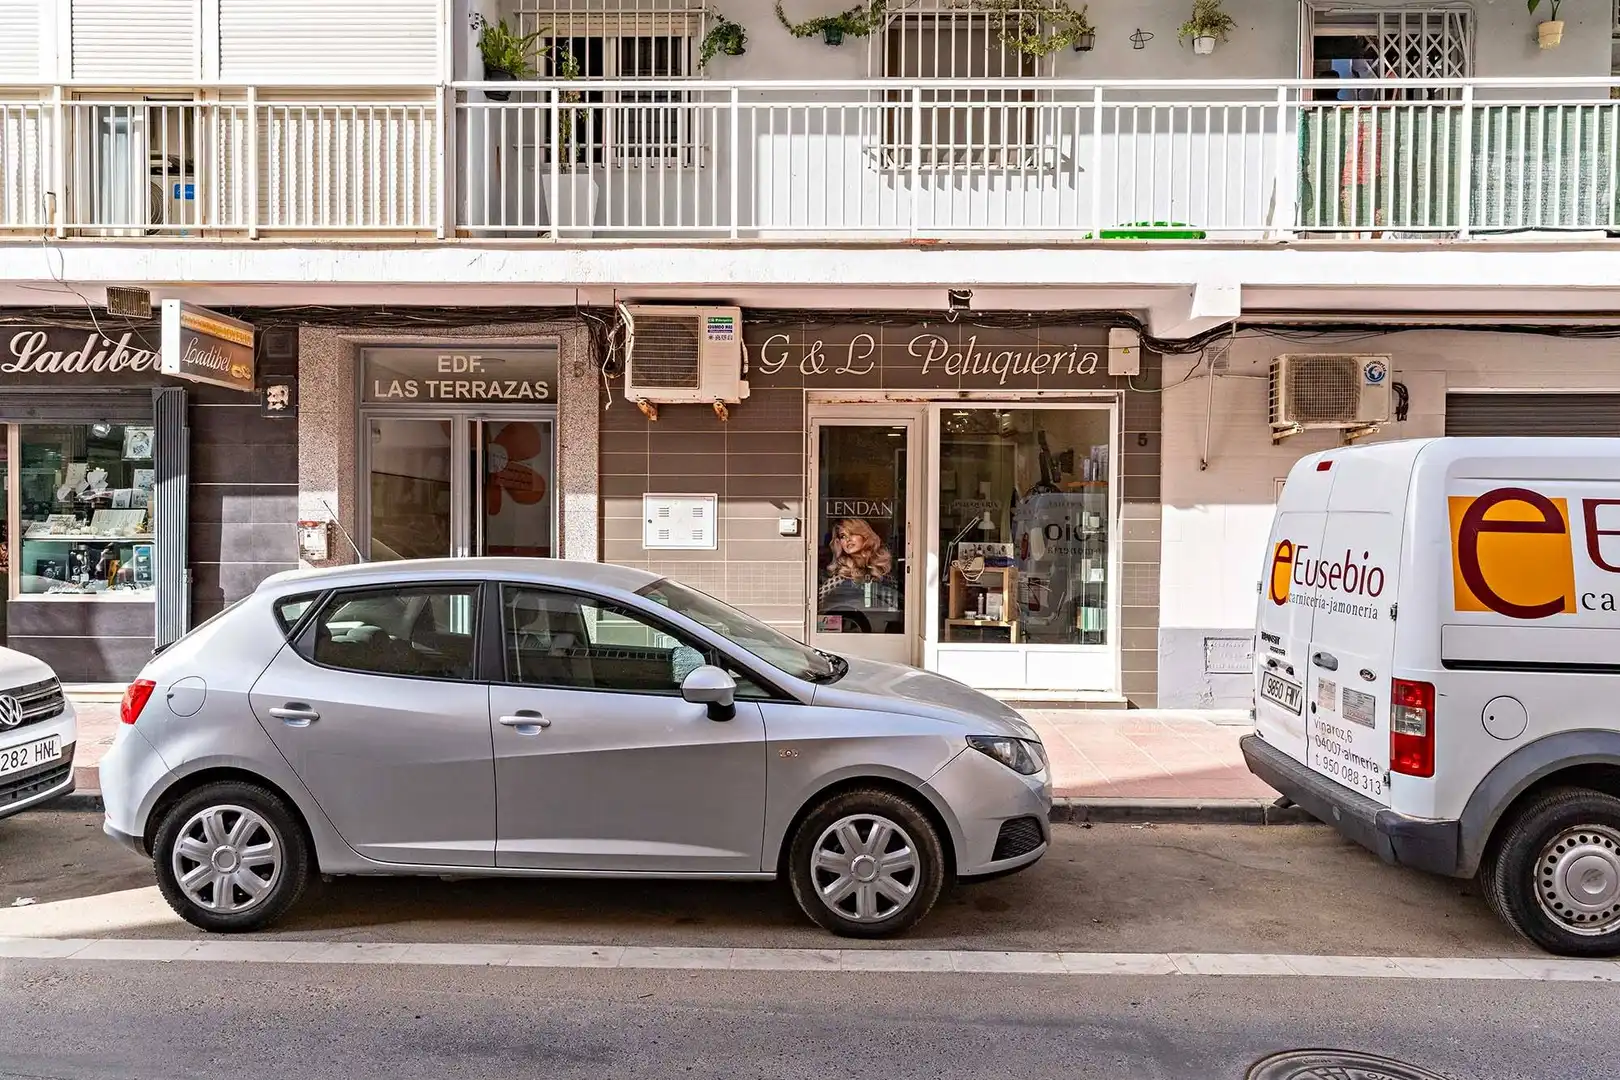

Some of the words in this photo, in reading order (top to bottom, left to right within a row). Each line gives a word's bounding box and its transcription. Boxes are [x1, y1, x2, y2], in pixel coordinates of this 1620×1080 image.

[437, 355, 485, 373] EDF.
[759, 334, 790, 375] G
[800, 340, 829, 375] &
[835, 334, 875, 375] L
[374, 380, 418, 398] LAS
[425, 380, 549, 399] TERRAZAS
[826, 501, 893, 516] LENDAN
[1293, 545, 1384, 597] Eusebio
[35, 740, 59, 762] HNL
[1323, 756, 1339, 775] 950
[1341, 766, 1359, 785] 088
[1362, 775, 1381, 795] 313
